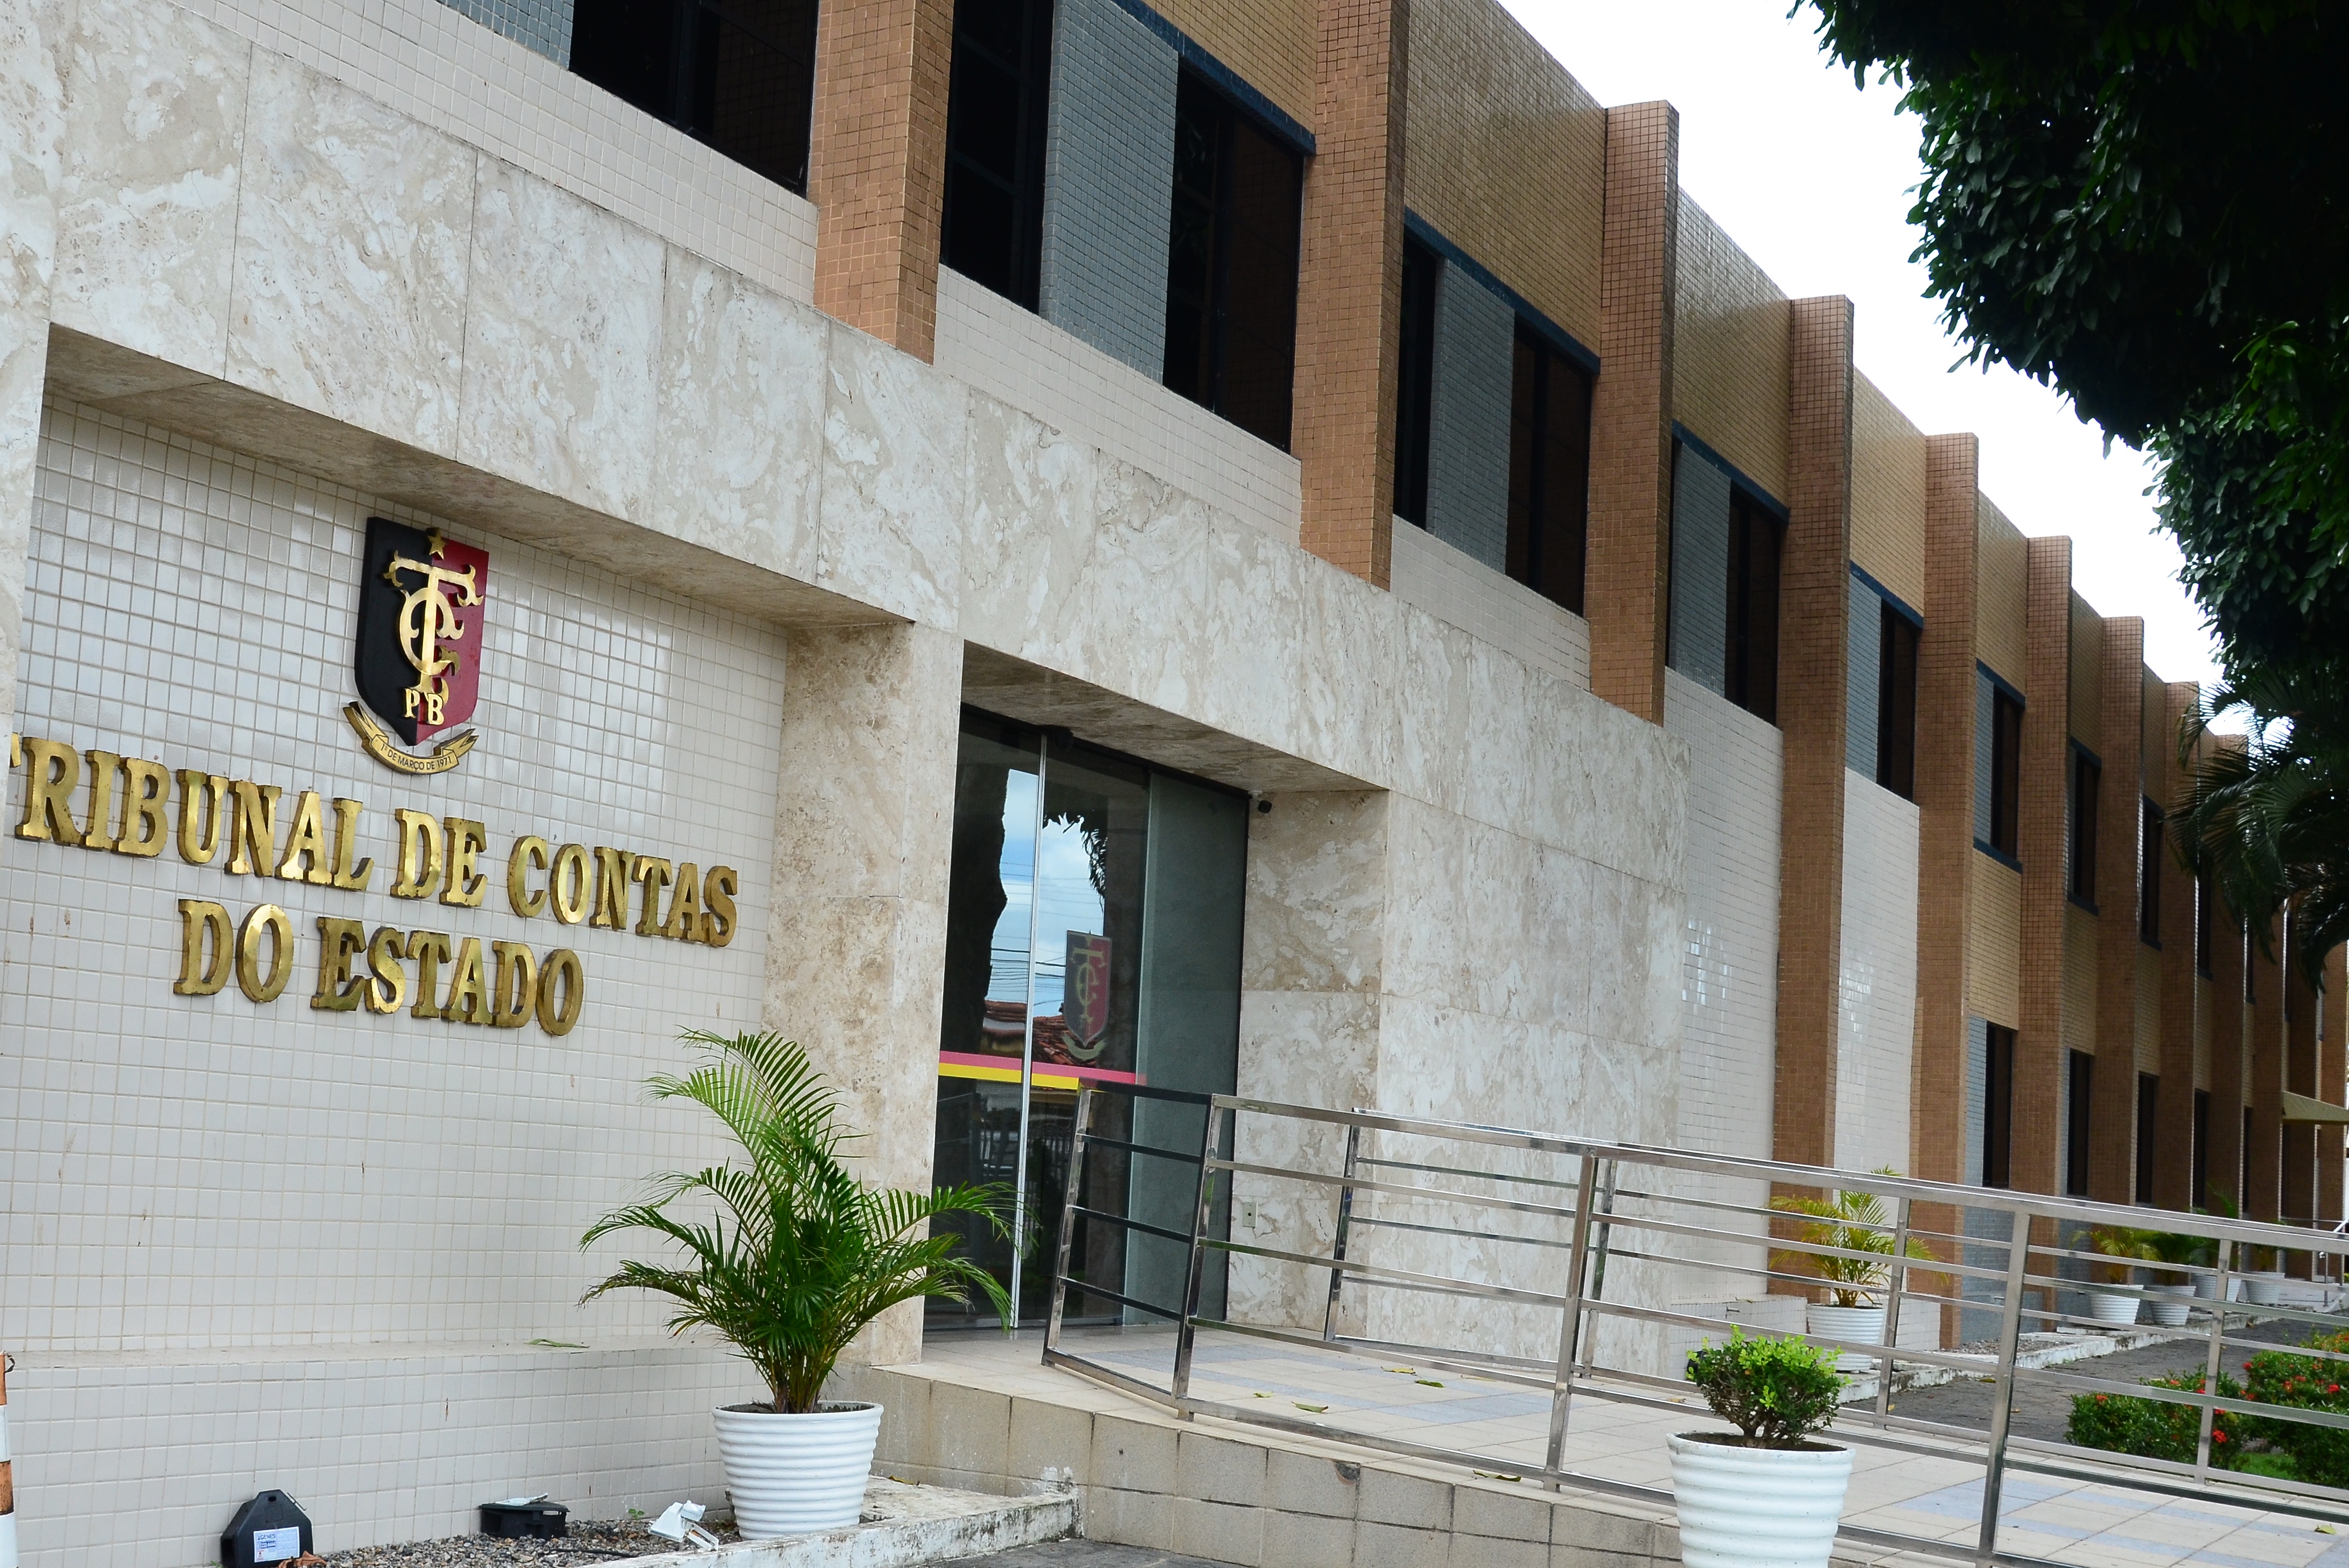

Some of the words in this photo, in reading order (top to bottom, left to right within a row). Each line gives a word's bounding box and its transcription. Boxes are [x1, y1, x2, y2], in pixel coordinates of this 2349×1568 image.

[404, 688, 445, 725] PB
[387, 750, 397, 761] DE
[397, 755, 425, 772] MARÇO
[437, 756, 452, 768] 1971
[390, 808, 488, 908] DE
[507, 835, 737, 947] CONTAS
[173, 899, 294, 1003] DO
[310, 916, 584, 1037] ESTADO
